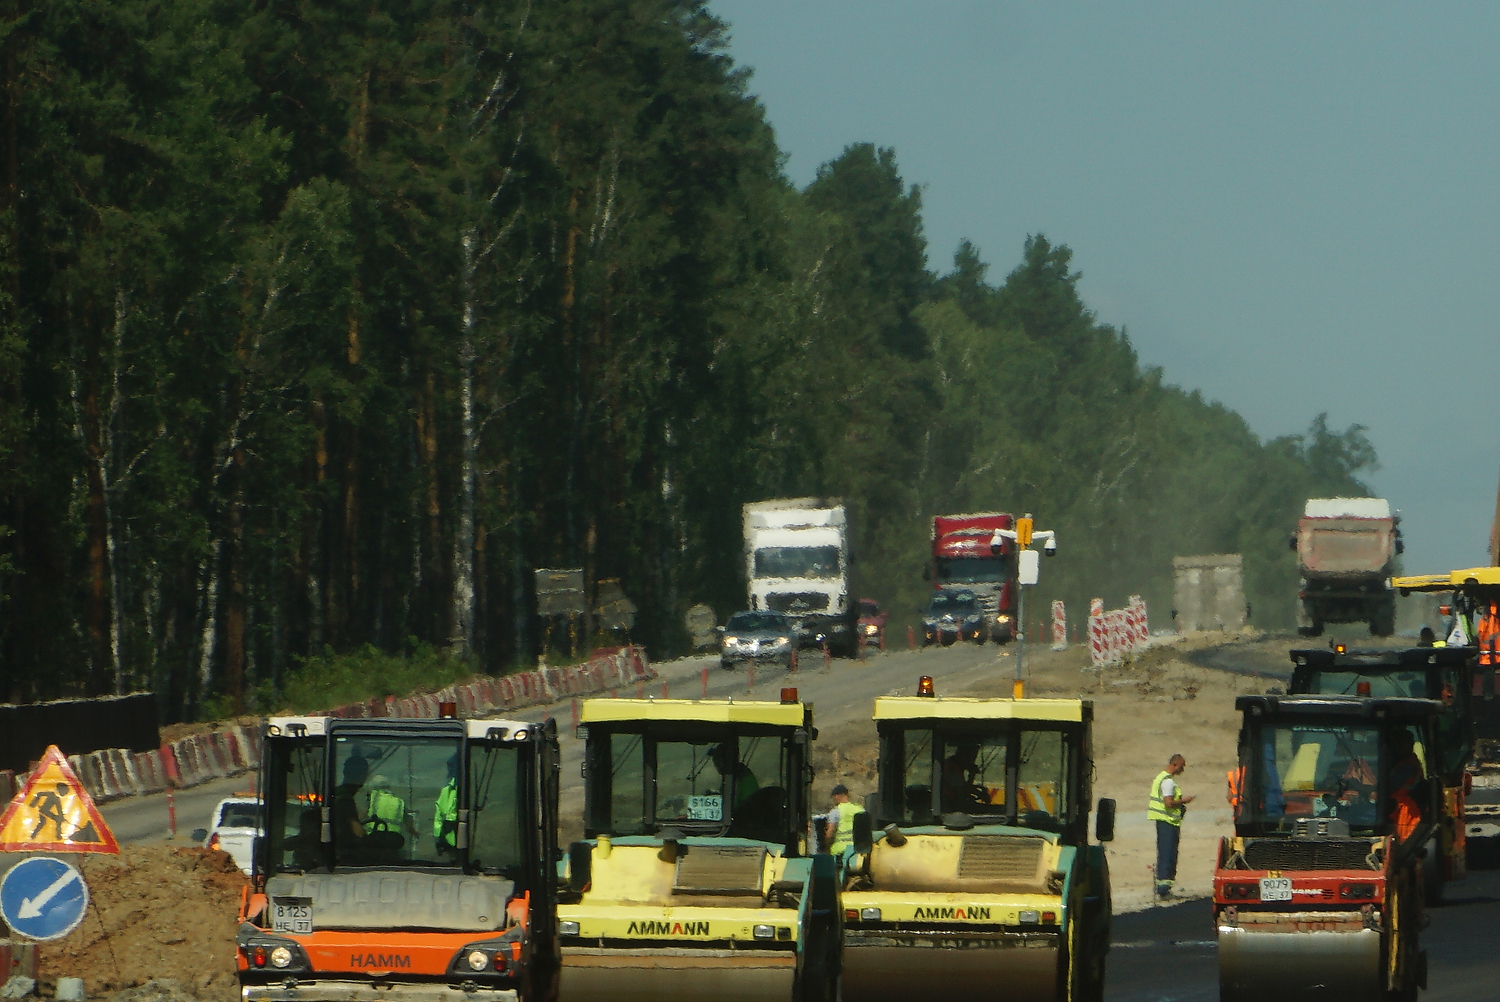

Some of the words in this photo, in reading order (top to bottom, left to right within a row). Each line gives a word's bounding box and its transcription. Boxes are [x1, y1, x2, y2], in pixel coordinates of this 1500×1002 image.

[914, 906, 990, 920] AMMANN
[296, 921, 309, 931] 37
[627, 920, 710, 936] AMMANN
[351, 953, 411, 968] HAMM
